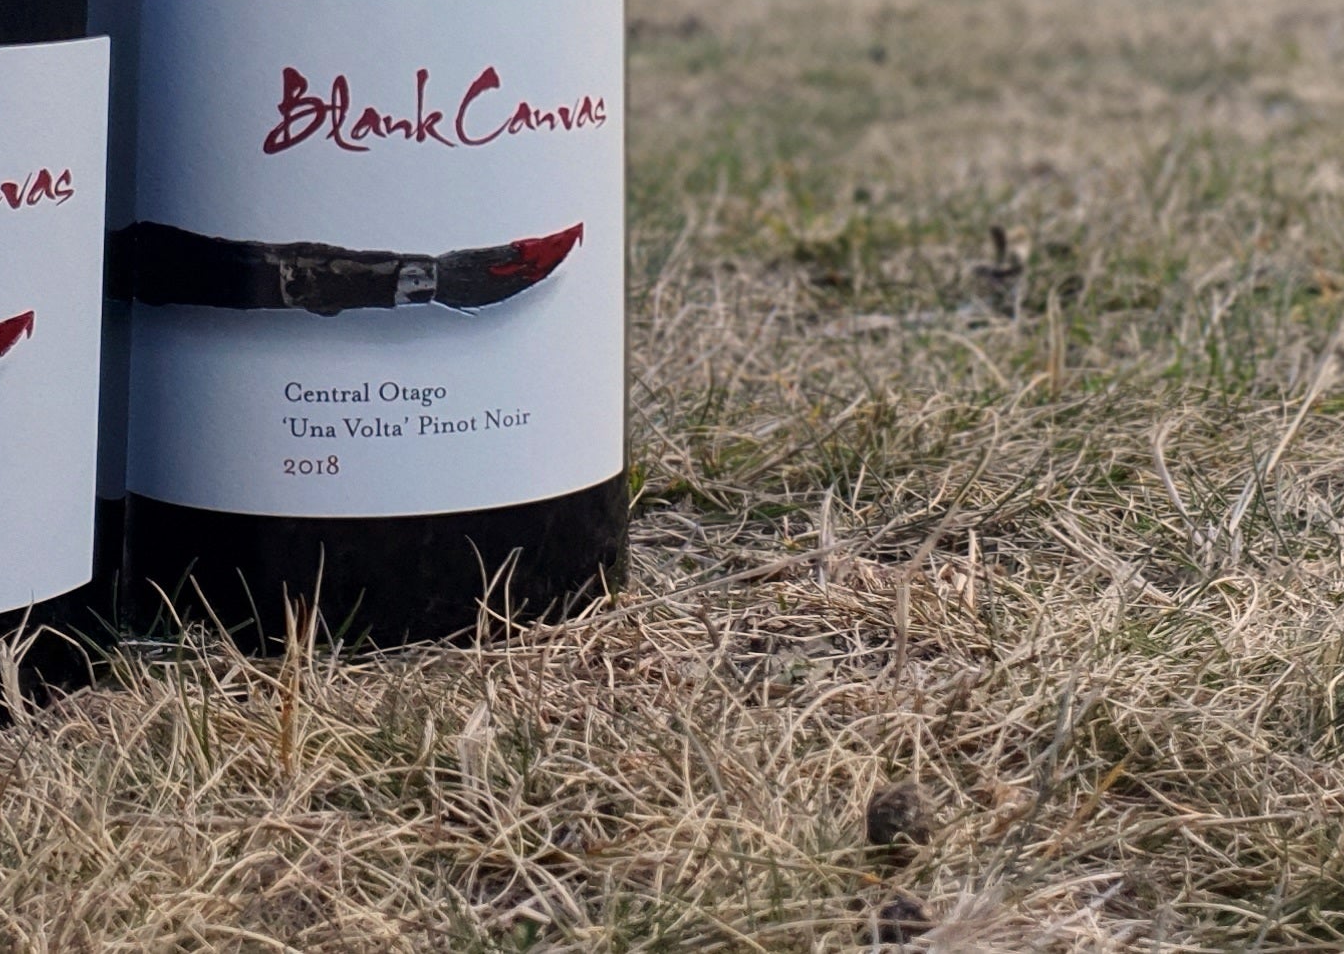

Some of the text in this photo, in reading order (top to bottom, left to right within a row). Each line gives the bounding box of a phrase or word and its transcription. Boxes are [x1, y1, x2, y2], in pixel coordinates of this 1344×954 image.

[262, 66, 607, 154] Blank Canvas
[283, 381, 447, 407] Central Otago
[417, 414, 478, 436] Pinot
[483, 408, 532, 430] Noir
[282, 454, 340, 477] 2018
